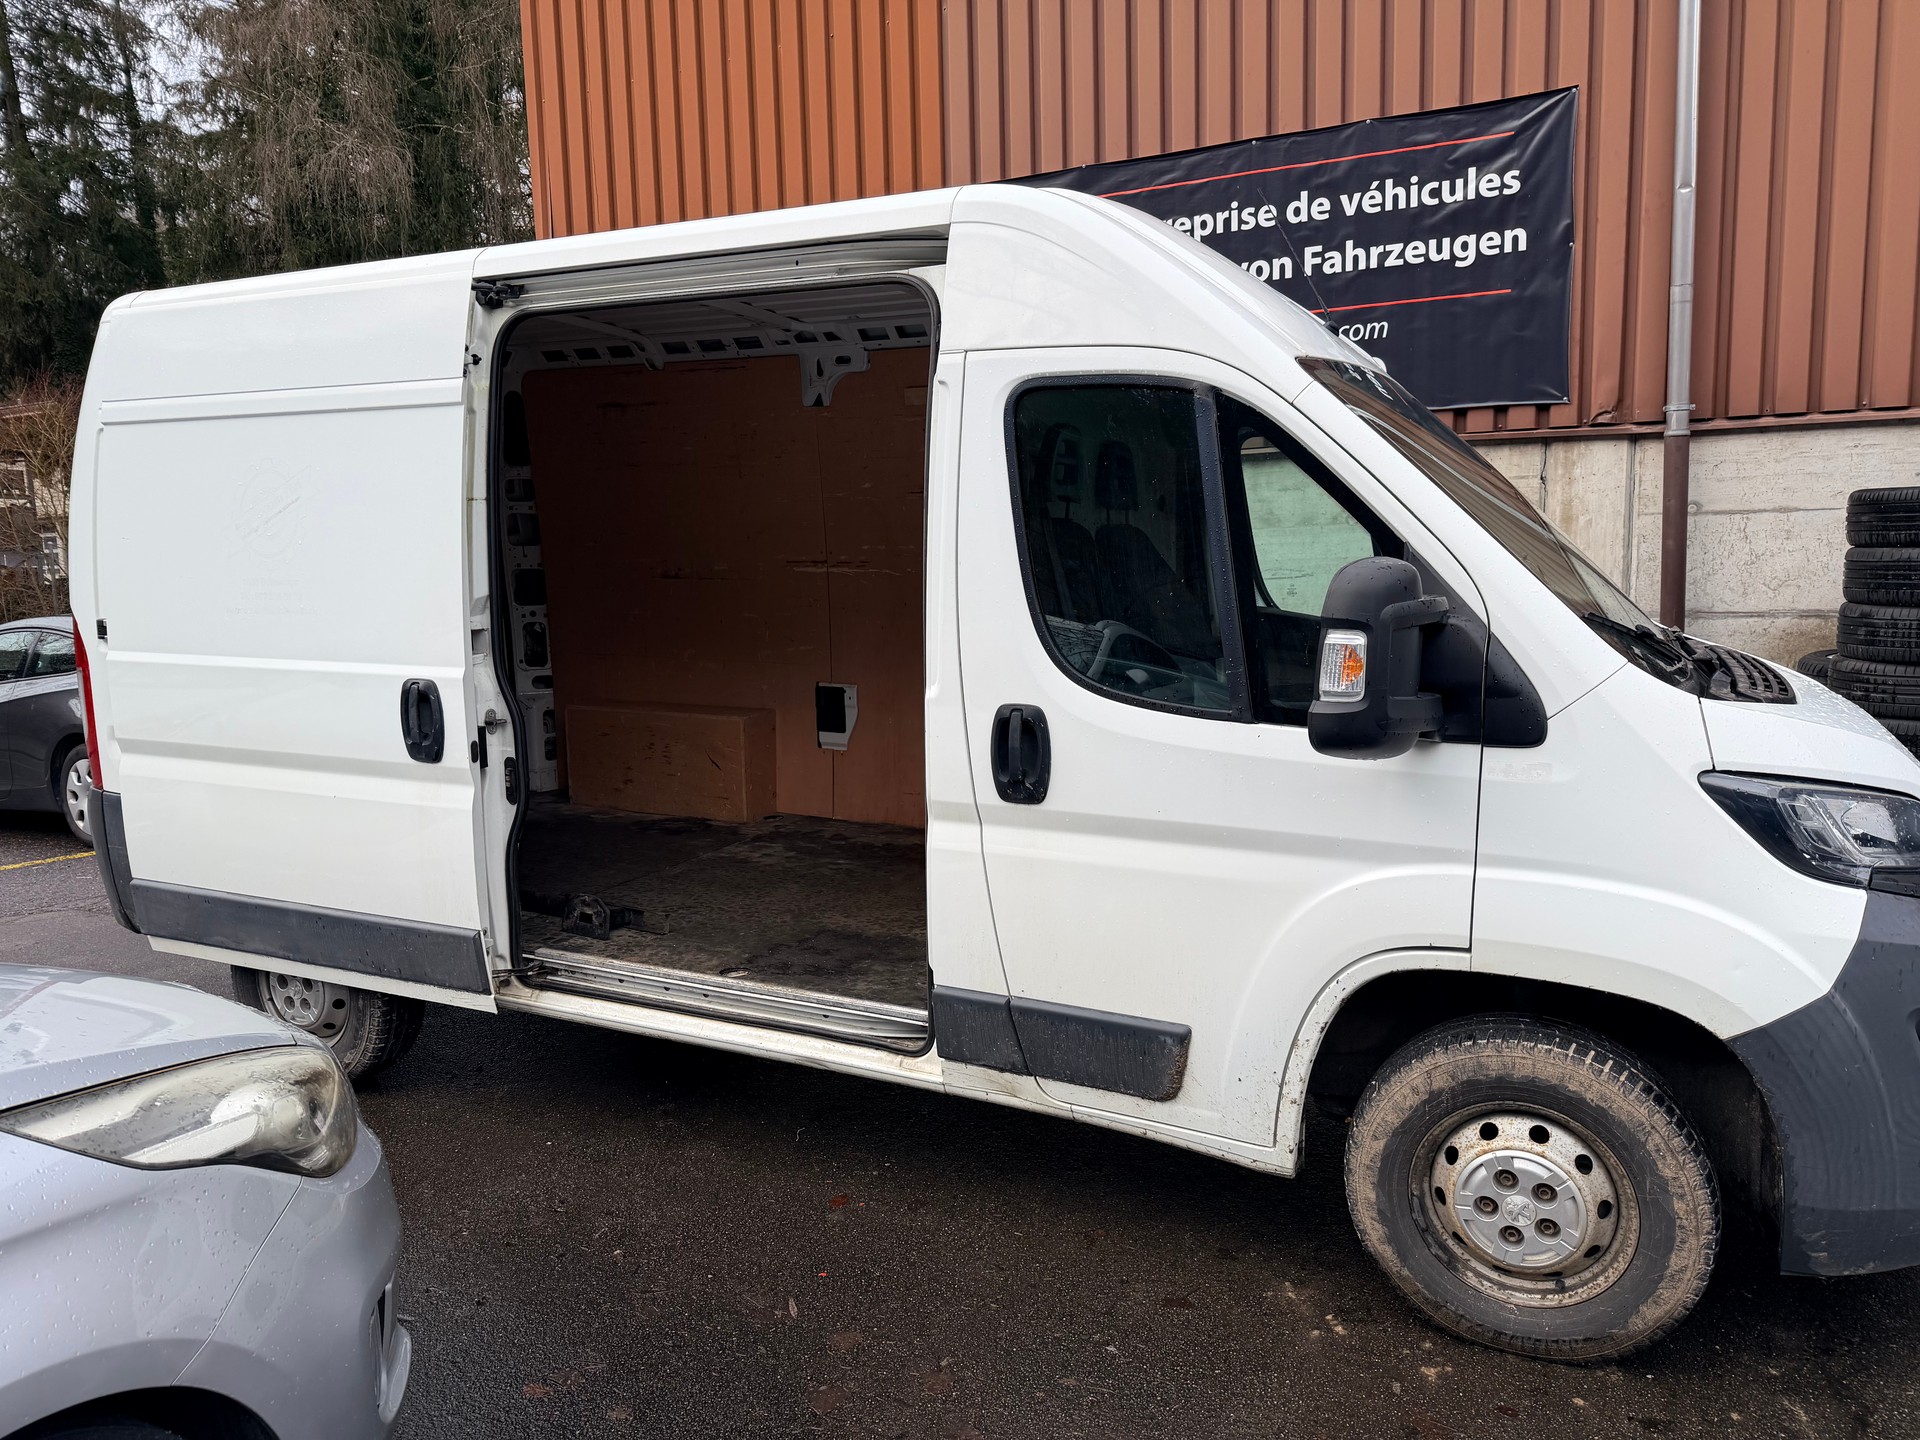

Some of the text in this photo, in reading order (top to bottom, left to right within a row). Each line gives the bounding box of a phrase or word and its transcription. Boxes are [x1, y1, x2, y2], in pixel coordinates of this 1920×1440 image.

[1286, 190, 1331, 224] de
[1340, 167, 1521, 216] véhicules
[1304, 227, 1527, 277] Fahrzeugen
